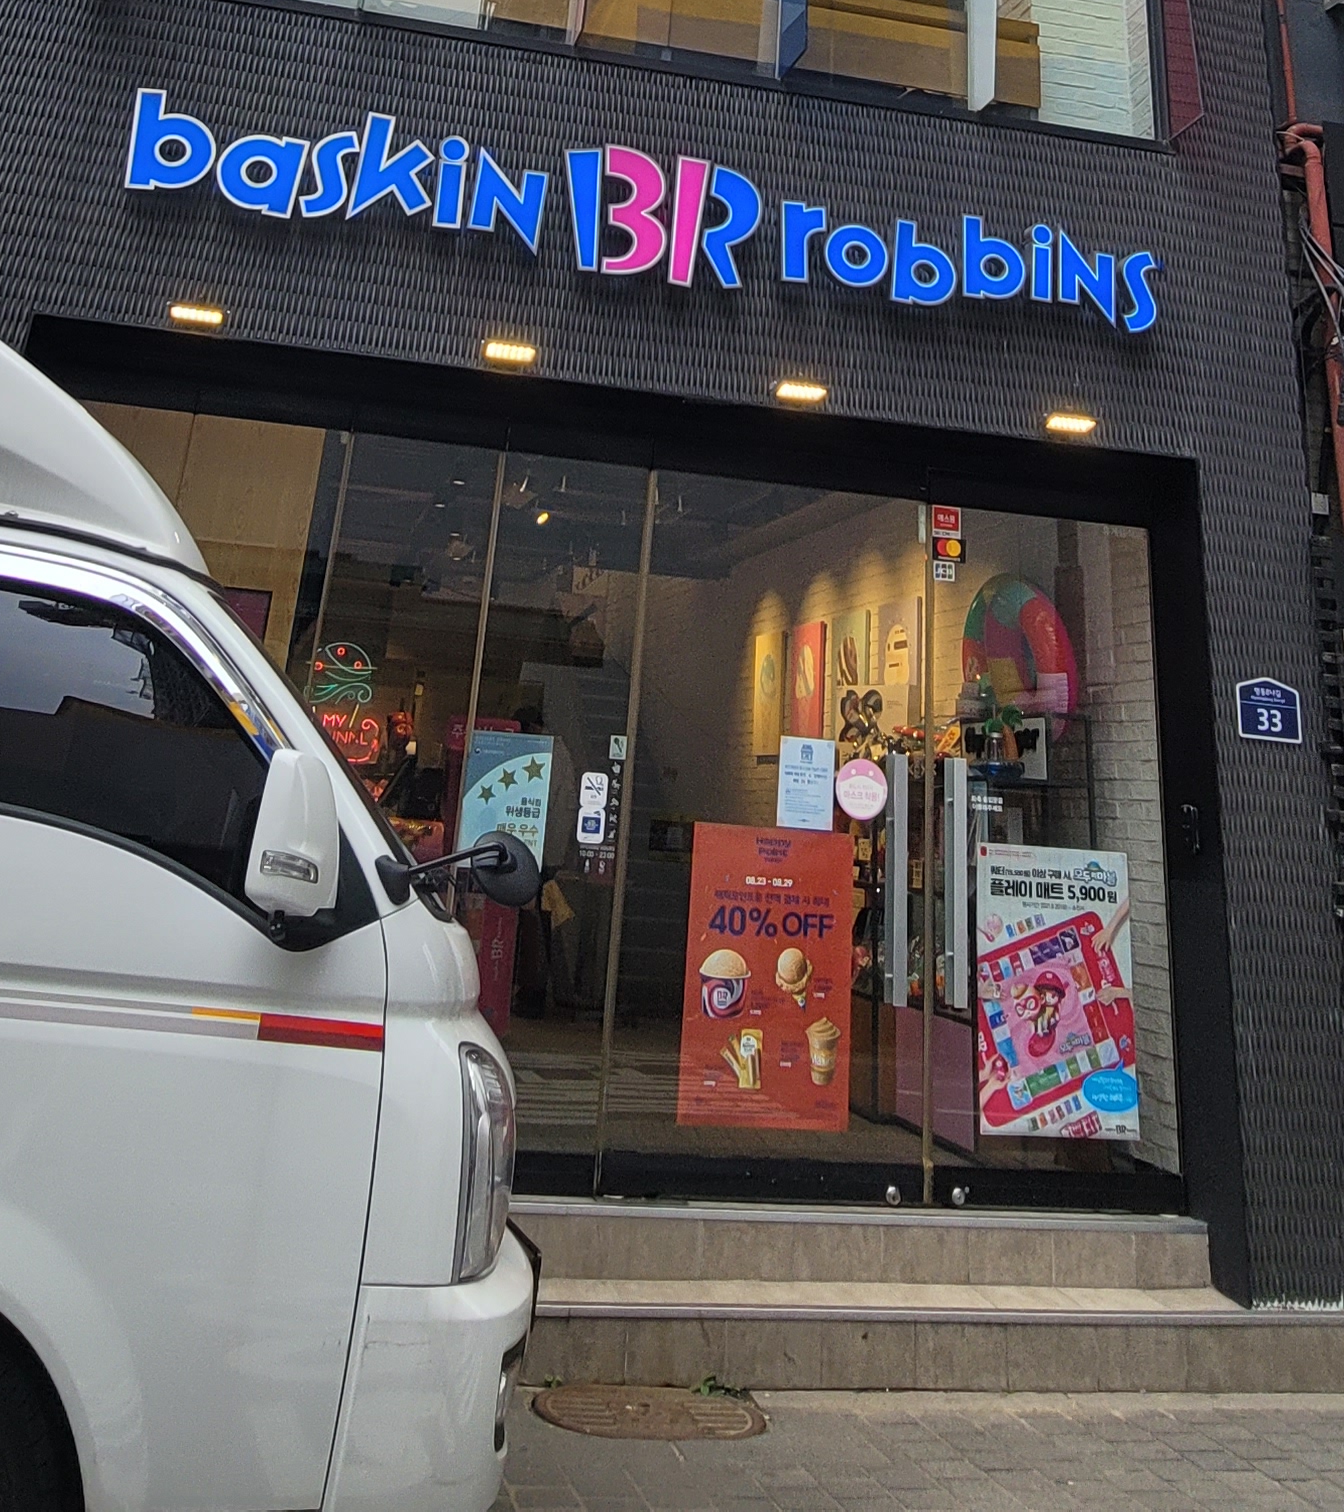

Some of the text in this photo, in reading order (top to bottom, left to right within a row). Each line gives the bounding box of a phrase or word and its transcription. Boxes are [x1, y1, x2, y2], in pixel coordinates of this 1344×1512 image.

[124, 87, 1163, 335] baskin BR robbins
[322, 714, 348, 728] MY
[1257, 708, 1282, 732] 33
[843, 790, 863, 799] 마스크
[505, 805, 541, 819] 위생등급
[517, 824, 539, 837] 우수
[746, 876, 794, 888] 08.23 08.29
[991, 878, 1032, 898] 플레이
[1036, 881, 1064, 899] 매트
[1068, 885, 1105, 903] 5,900
[708, 905, 834, 938] 40% OFF
